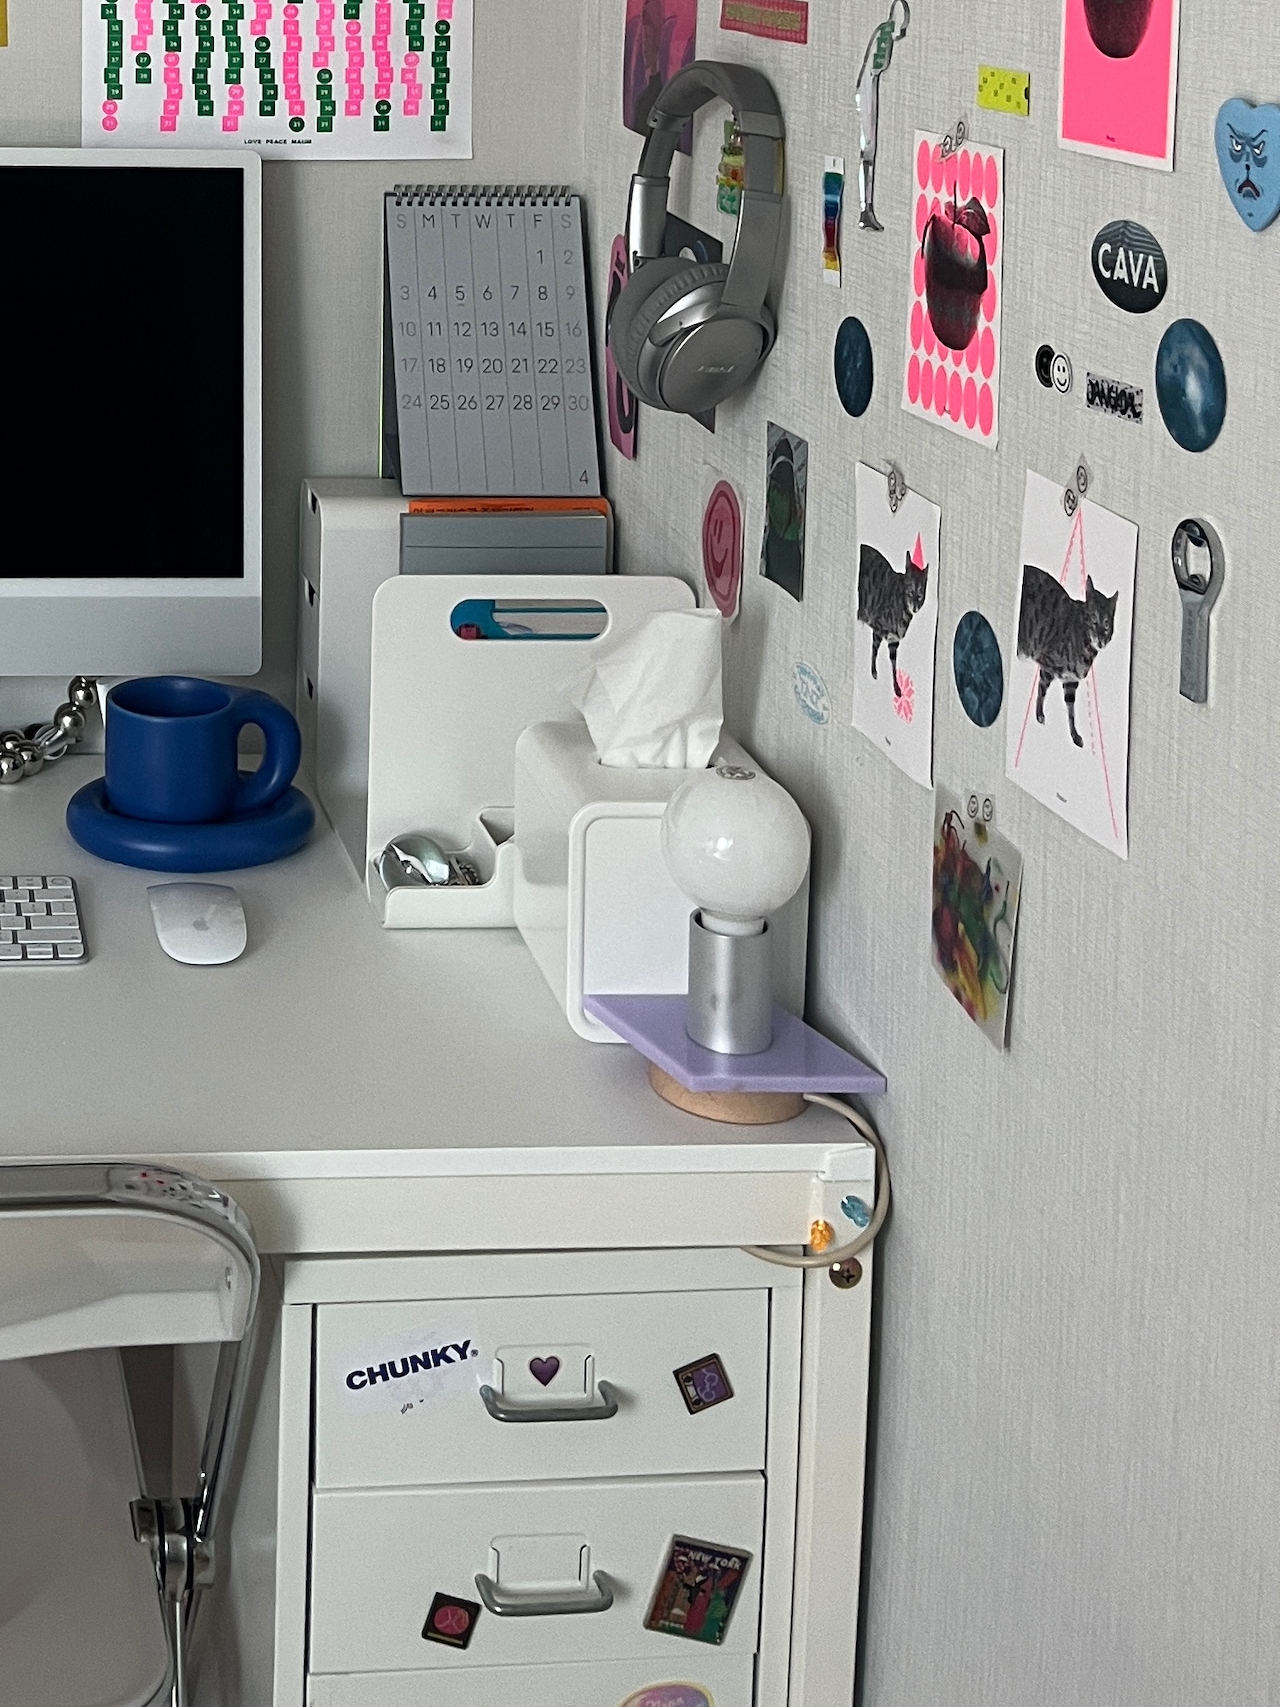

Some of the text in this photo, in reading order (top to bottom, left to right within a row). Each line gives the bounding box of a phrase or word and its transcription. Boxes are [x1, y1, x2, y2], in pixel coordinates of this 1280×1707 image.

[422, 214, 436, 229] M
[451, 214, 461, 229] T
[475, 214, 491, 229] W
[506, 214, 515, 229] T
[533, 214, 542, 229] F
[537, 250, 544, 264] 1
[1098, 243, 1160, 294] CAVA
[399, 285, 575, 301] 3 4 5 6 7 8 9
[398, 321, 582, 337] 10 11 12 13 14 15 16
[401, 358, 586, 374] 17 18 19 20 21 22 23
[401, 394, 589, 411] 24 25 26 27 28 29 30
[579, 470, 589, 485] 4
[688, 1550, 712, 1562] NEW
